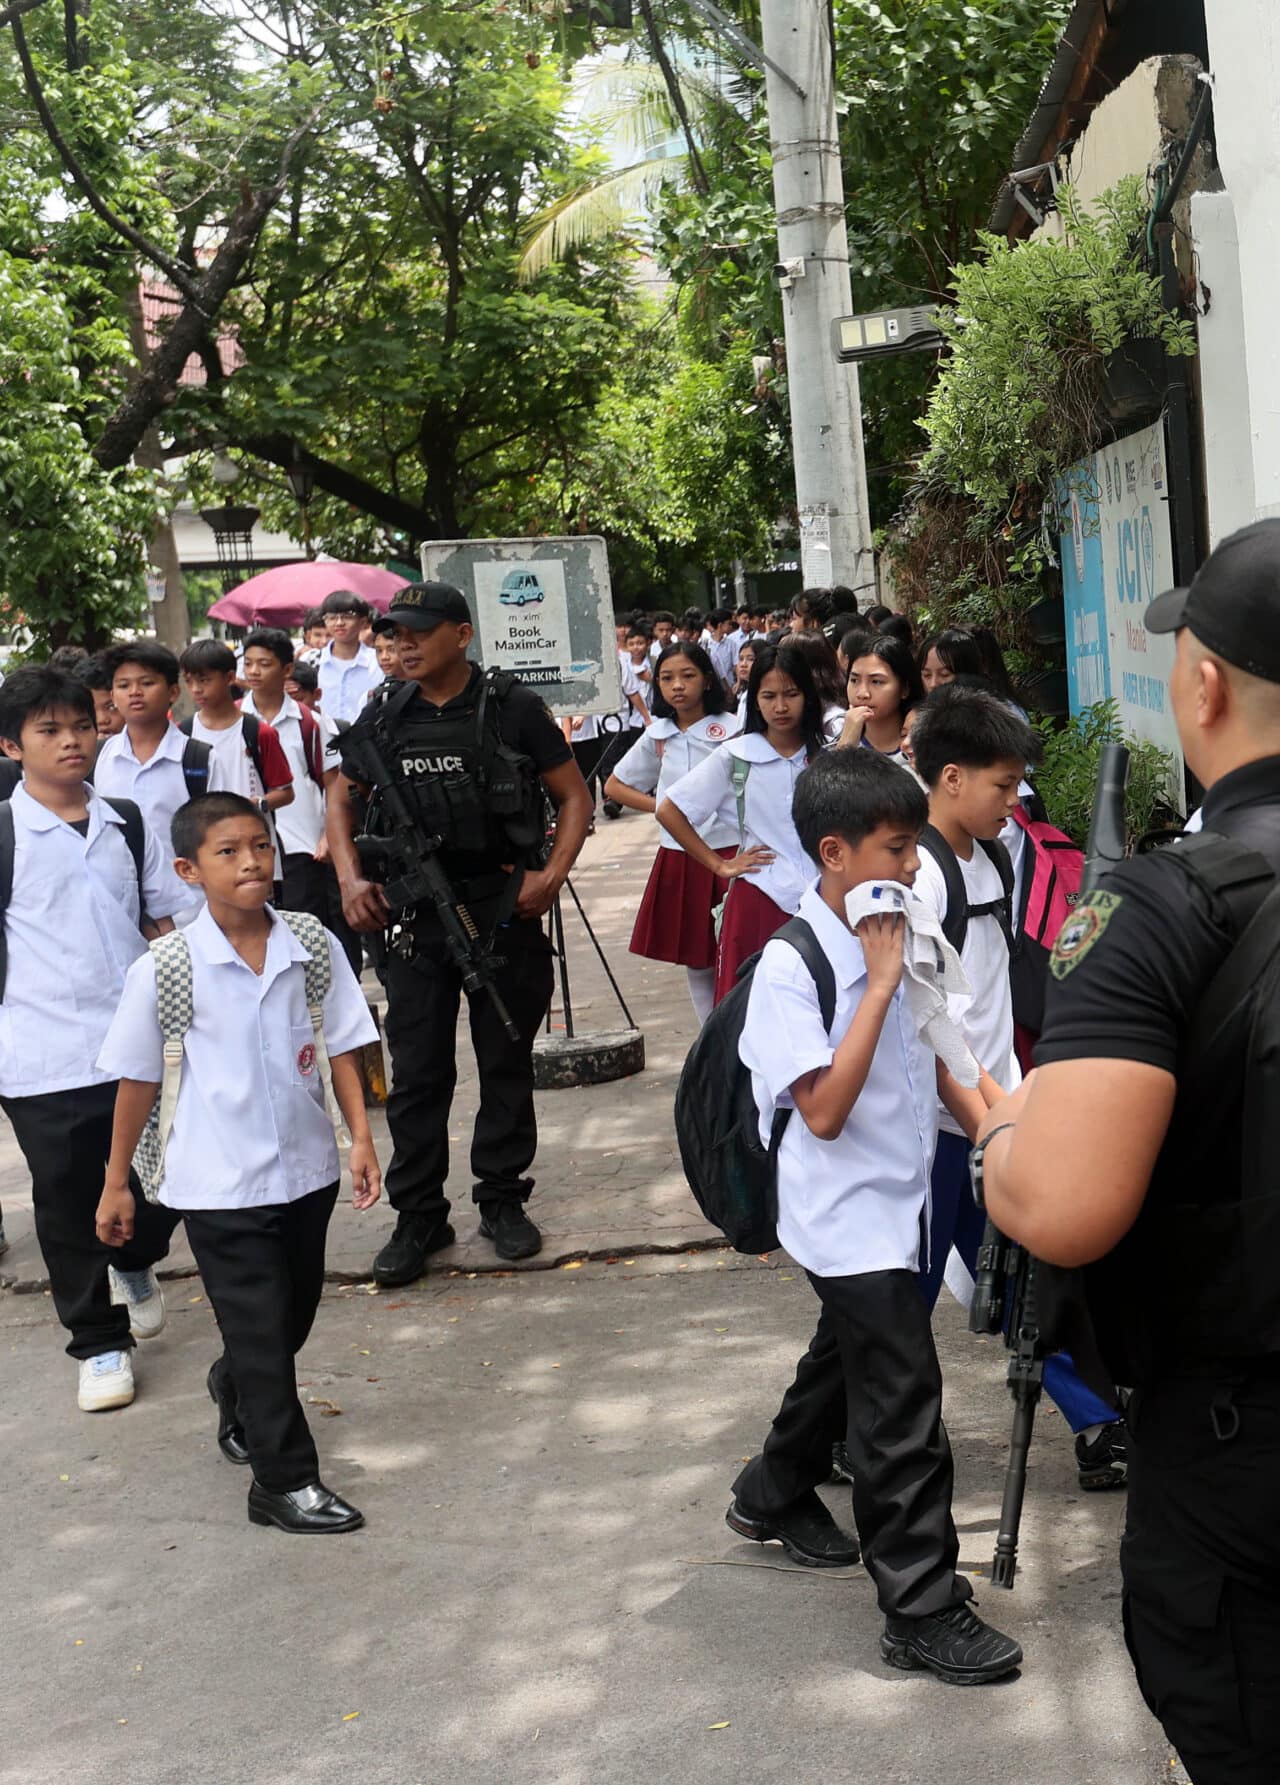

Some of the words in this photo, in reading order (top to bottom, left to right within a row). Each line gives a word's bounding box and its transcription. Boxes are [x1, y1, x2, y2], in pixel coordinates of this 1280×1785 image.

[1117, 518, 1142, 603] JCI
[508, 612, 540, 622] mxim
[509, 626, 541, 638] Book
[495, 638, 558, 651] MaximCar
[402, 755, 464, 776] POLICE
